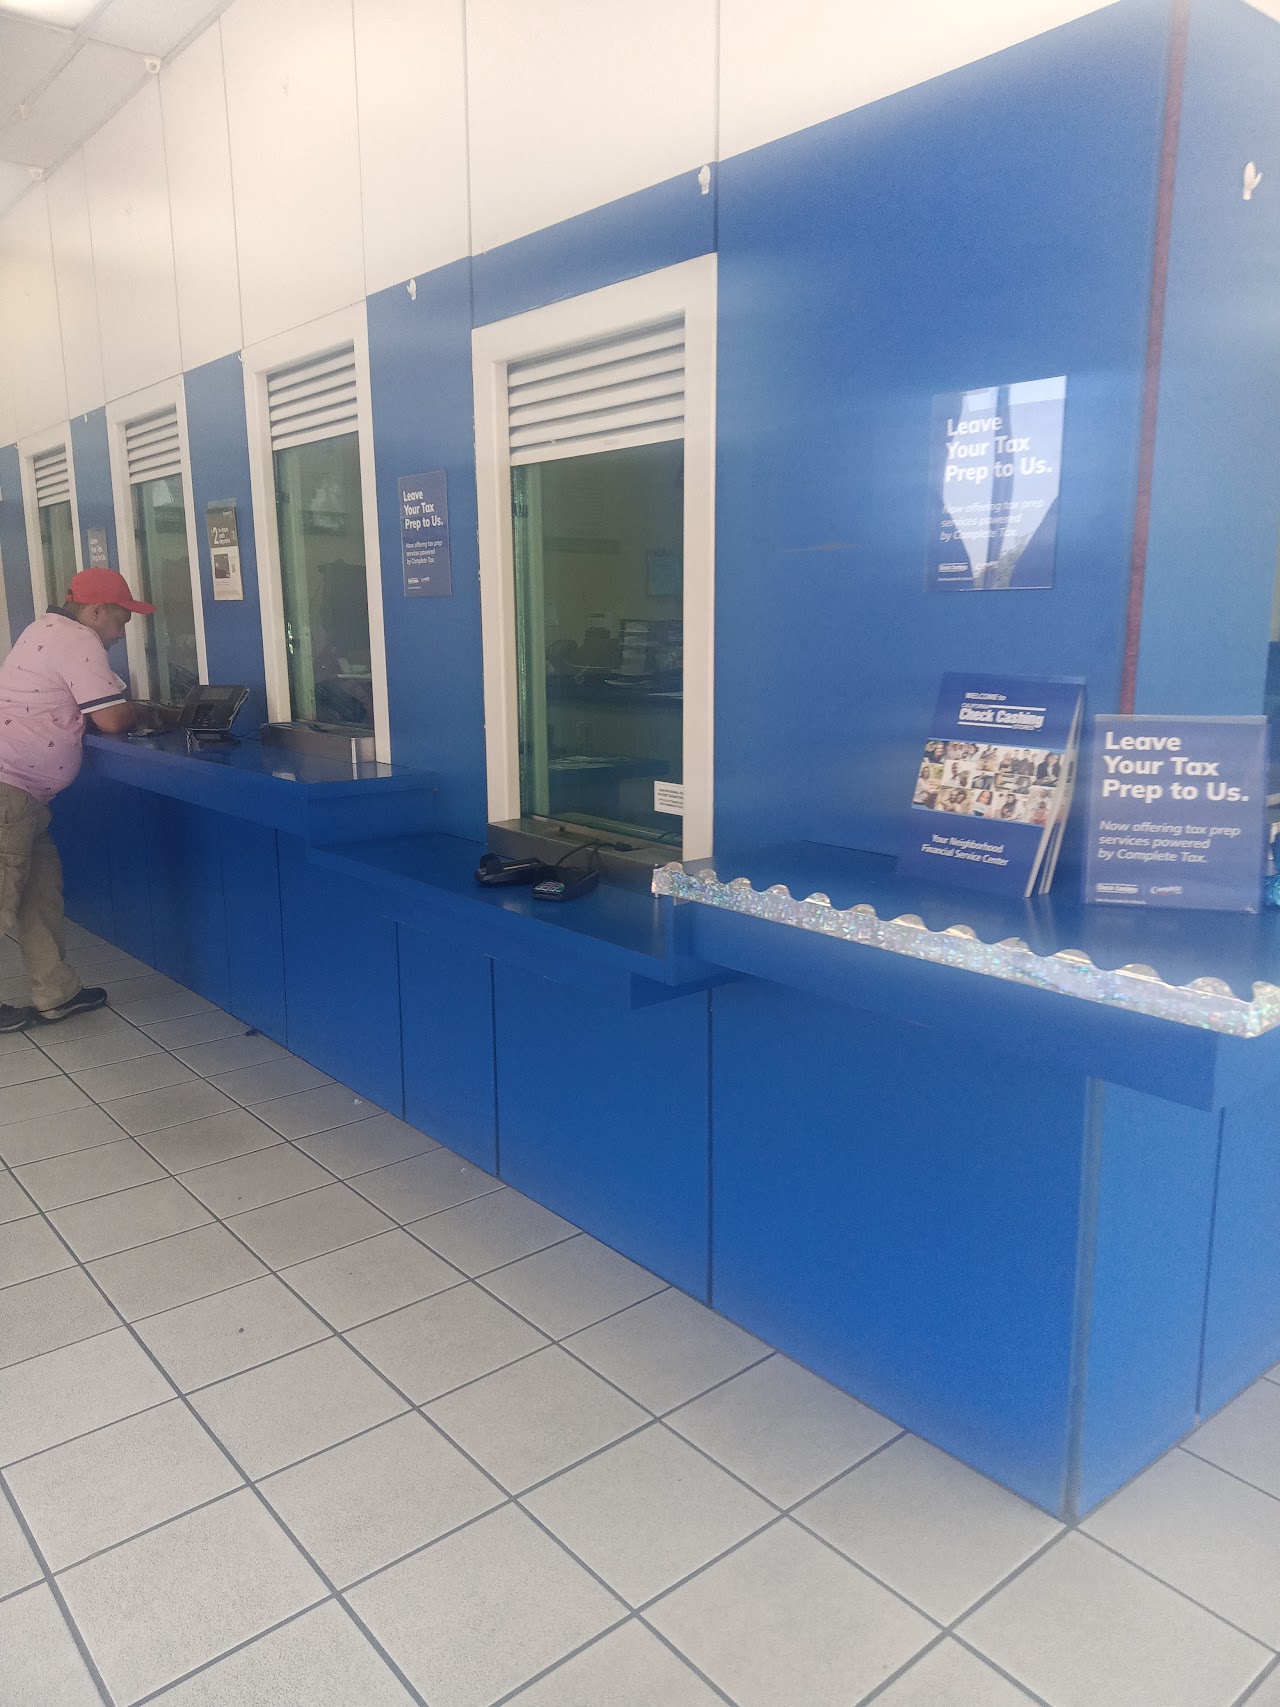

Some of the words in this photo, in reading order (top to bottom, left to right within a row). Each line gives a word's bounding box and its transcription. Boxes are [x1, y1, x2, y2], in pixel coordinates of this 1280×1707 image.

[946, 416, 1002, 437] Leave
[945, 441, 990, 460] Your
[994, 435, 1031, 454] Tax
[944, 465, 988, 485] Prep
[993, 461, 1014, 478] to
[1020, 456, 1054, 476] Us.
[403, 491, 423, 501] Leave
[403, 504, 420, 515] Your
[421, 502, 434, 513] Tax
[404, 518, 421, 531] Prep
[422, 517, 430, 528] to
[431, 515, 444, 527] Us.
[939, 531, 953, 543] by
[959, 708, 995, 722] Check
[996, 710, 1045, 729] Cashing
[1104, 731, 1182, 751] Leave
[1102, 755, 1164, 775] Your
[1170, 757, 1220, 777] Tax
[1102, 779, 1163, 804] Prep
[1170, 782, 1199, 801] to
[1206, 781, 1250, 802] Us.
[1100, 820, 1130, 831] Now
[1131, 821, 1182, 836] offering
[1185, 824, 1207, 835] tax
[1208, 826, 1241, 838] prep
[932, 834, 949, 844] Your
[949, 837, 1005, 853] Neighborhood
[1098, 835, 1150, 847] services
[1151, 838, 1212, 849] powered
[921, 843, 955, 857] Financial
[953, 849, 982, 862] Service
[982, 854, 1009, 866] Center
[1097, 848, 1114, 860] by
[1117, 849, 1177, 862] Complete
